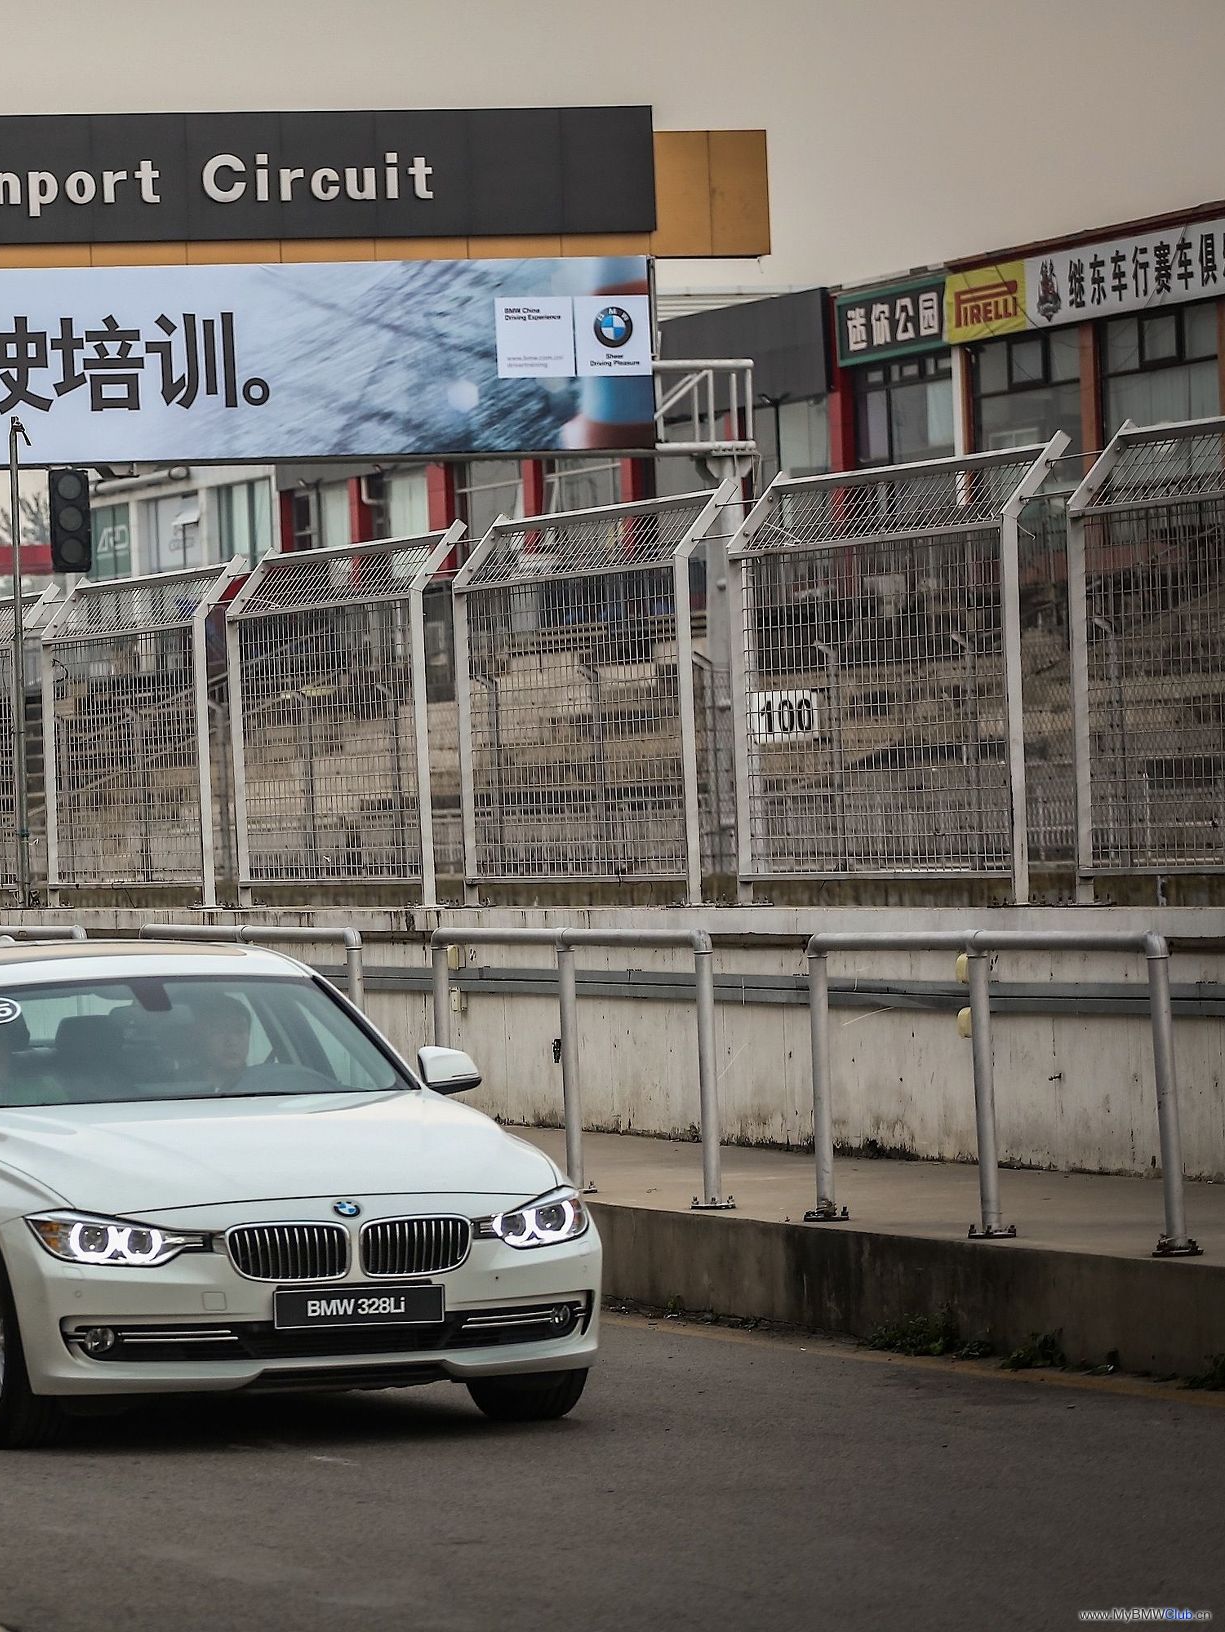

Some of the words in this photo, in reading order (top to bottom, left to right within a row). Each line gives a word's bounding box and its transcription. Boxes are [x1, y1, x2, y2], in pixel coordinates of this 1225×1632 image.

[201, 151, 435, 203] Circuit
[1068, 233, 1225, 309] 继东车行赛车俱
[846, 291, 939, 352] 迷你公园
[954, 280, 1019, 329] PIRELLI
[760, 699, 814, 733] 100
[307, 1299, 355, 1317] BMW
[357, 1296, 405, 1314] 328Li
